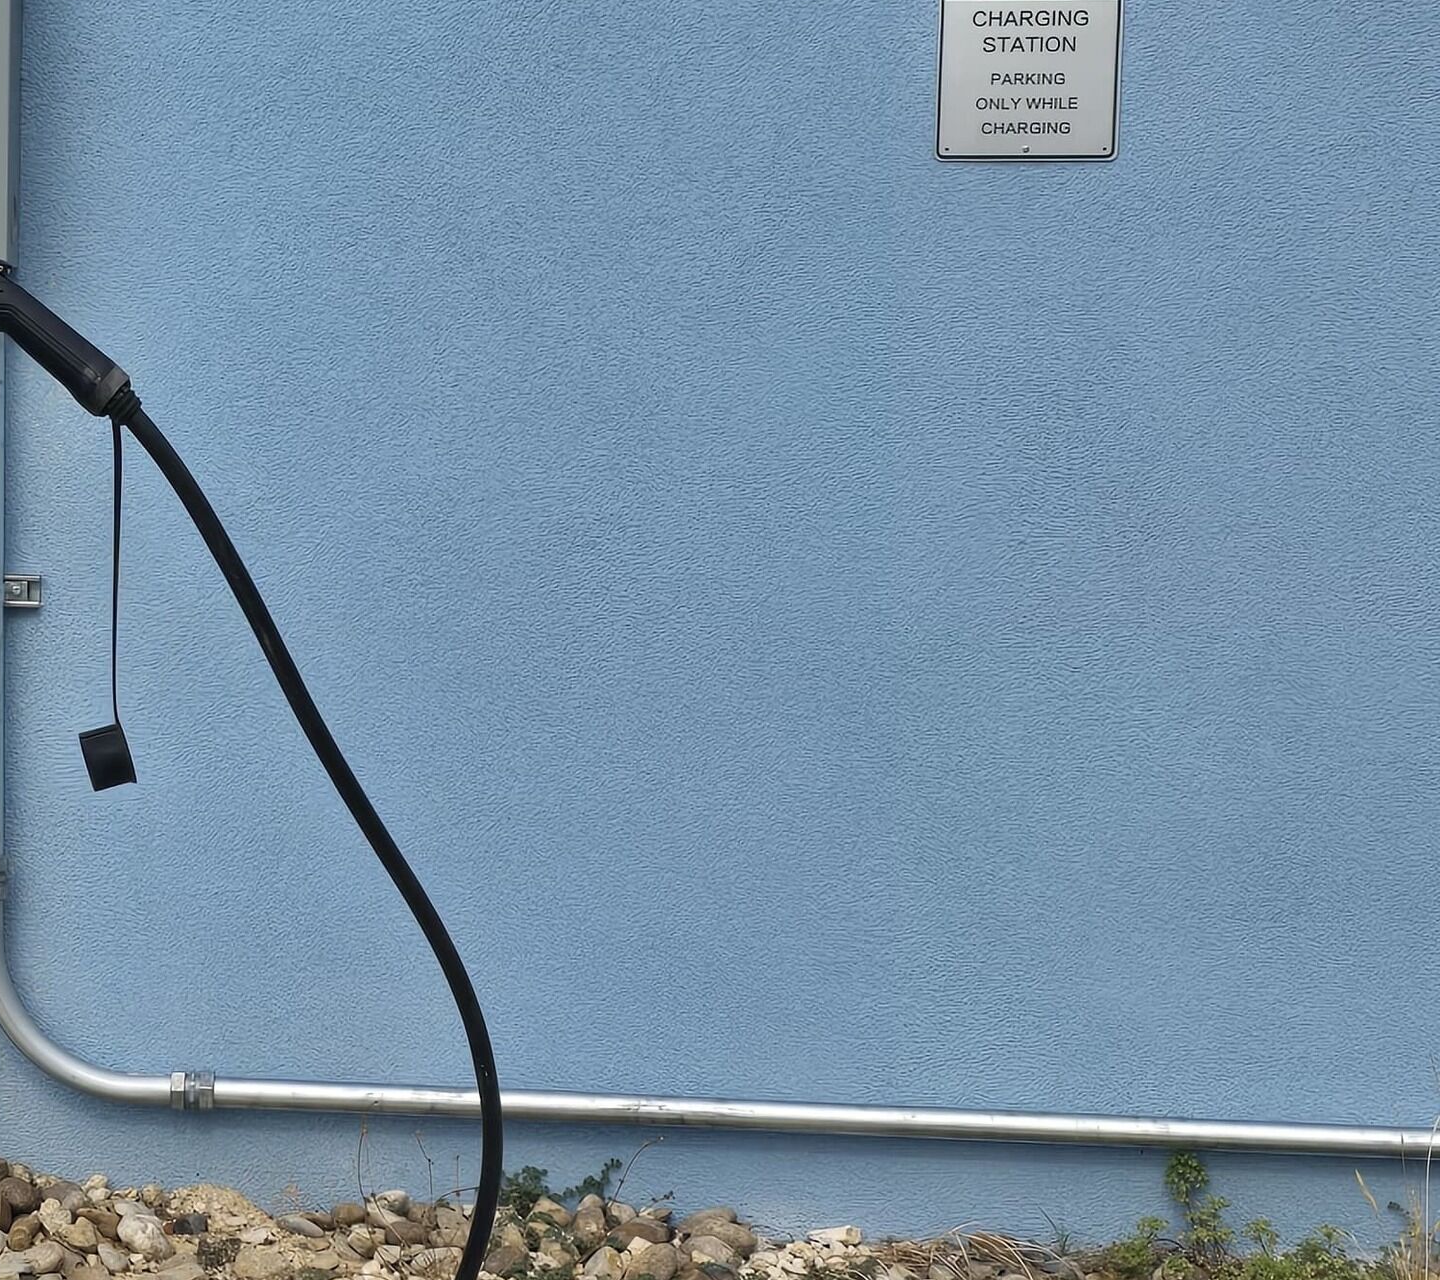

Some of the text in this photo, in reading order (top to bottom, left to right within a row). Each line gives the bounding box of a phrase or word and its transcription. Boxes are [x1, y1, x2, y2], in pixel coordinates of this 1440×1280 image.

[973, 10, 1088, 26] CHARGING
[983, 37, 1076, 52] STATION
[991, 73, 1065, 85] PARKING
[976, 97, 1077, 110] ONLY WHILE
[982, 122, 1070, 134] CHARGING
